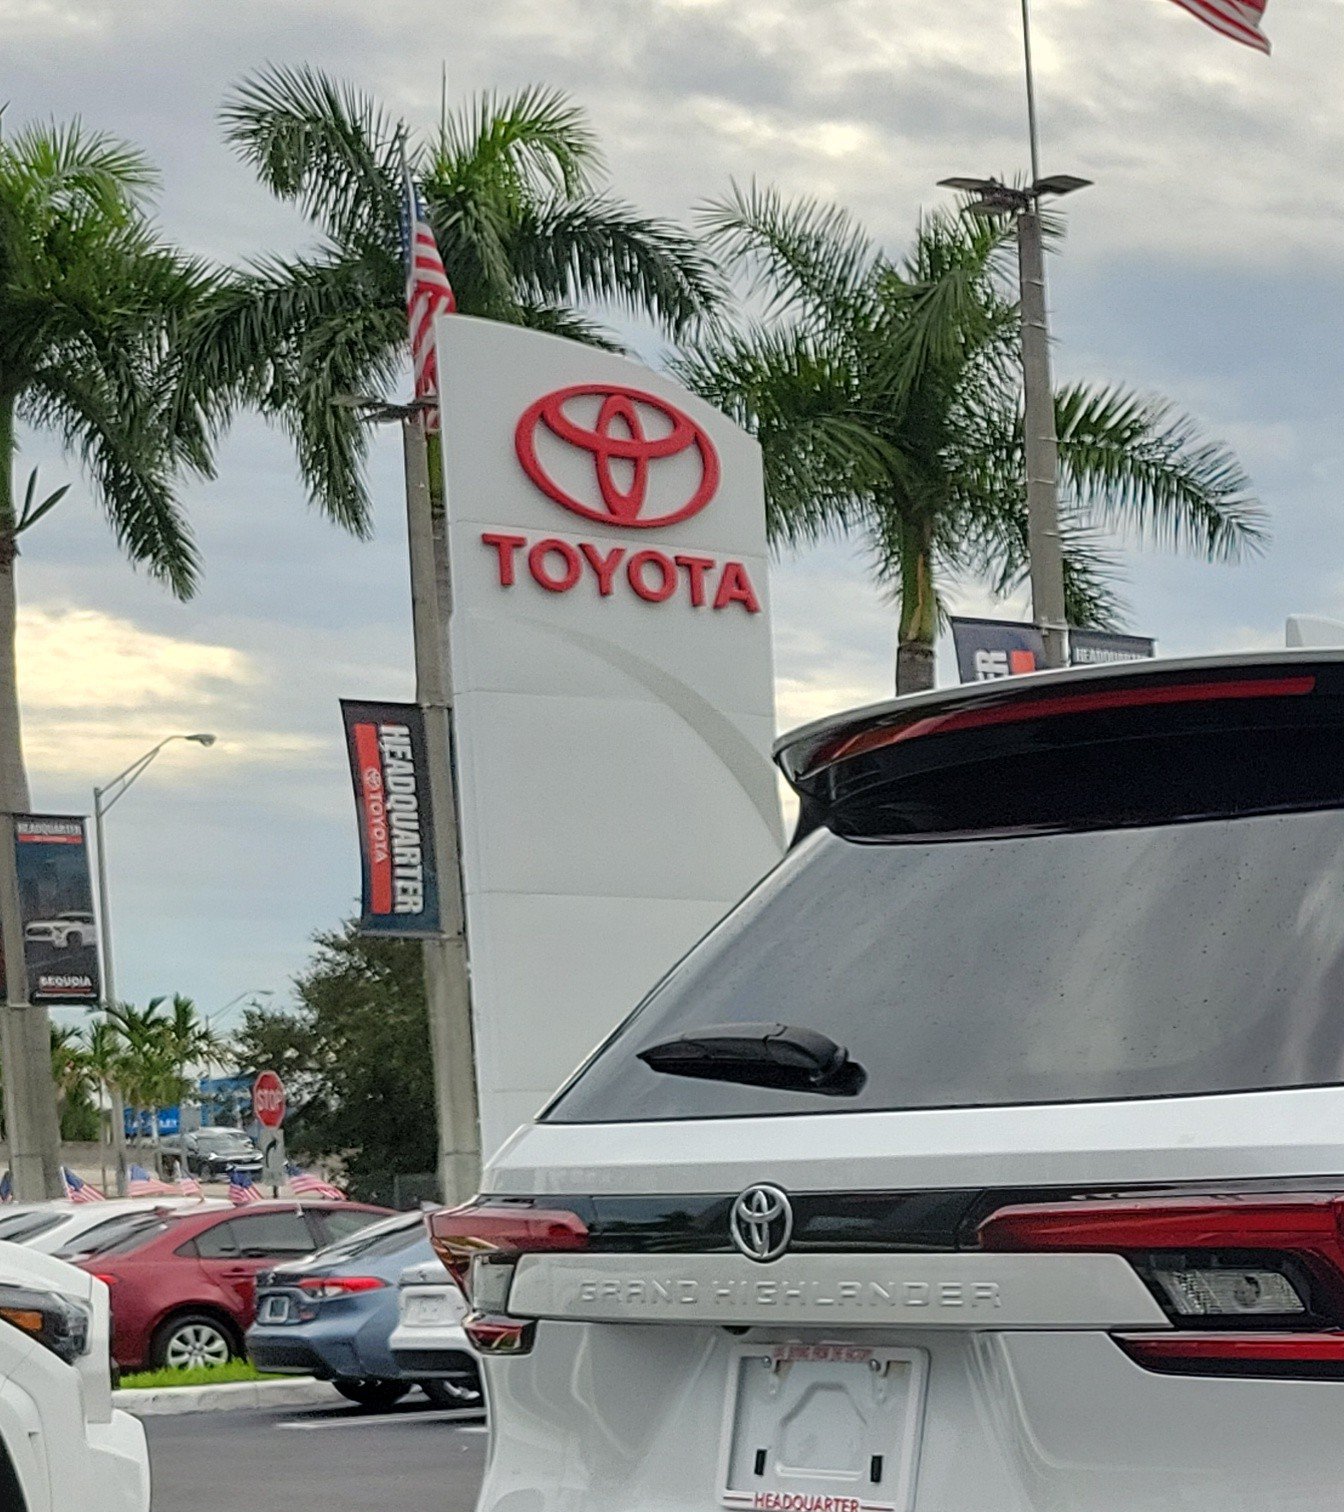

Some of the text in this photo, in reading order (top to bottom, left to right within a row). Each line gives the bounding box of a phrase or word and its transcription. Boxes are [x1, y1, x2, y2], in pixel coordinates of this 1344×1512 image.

[481, 532, 761, 614] TOYOTA
[367, 791, 391, 863] TOYOTA
[379, 723, 425, 914] HEADQUARTER
[39, 975, 92, 988] SEQUOIA
[256, 1088, 284, 1111] STOP
[579, 1281, 1001, 1308] GRAND HIGHLANDER
